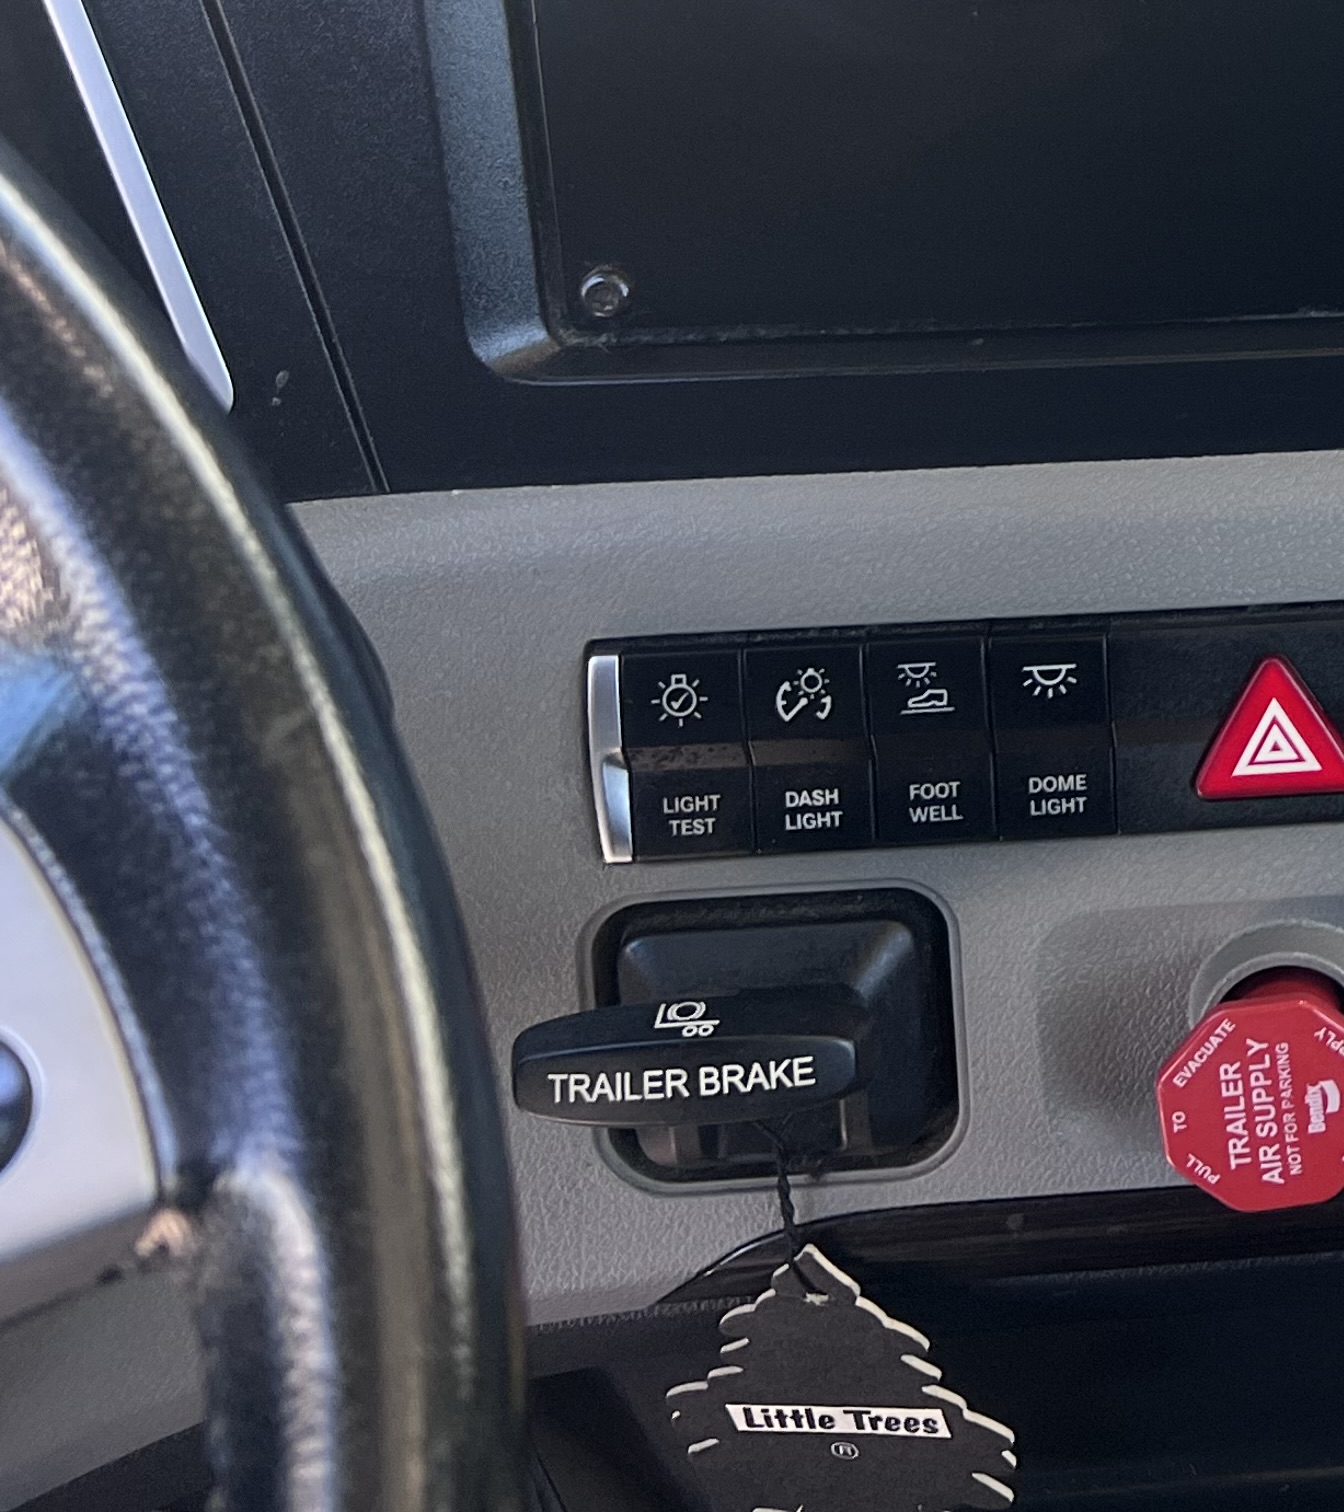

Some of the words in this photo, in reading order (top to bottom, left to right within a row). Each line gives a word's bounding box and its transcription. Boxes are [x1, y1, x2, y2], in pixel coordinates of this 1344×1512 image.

[909, 781, 961, 800] FOOT
[1029, 773, 1087, 793] DOME
[663, 794, 721, 814] LIGHT
[785, 788, 839, 808] DASH
[1030, 796, 1087, 816] LIGHT
[669, 817, 716, 836] TEST
[785, 811, 843, 830] LIGHT
[909, 804, 963, 823] WELL
[1173, 1018, 1236, 1088] EVACUATE
[548, 1067, 689, 1104] TRAILER
[699, 1056, 816, 1097] BRAKE
[1246, 1039, 1278, 1138] SUPPLY
[1276, 1042, 1296, 1111] PARKING
[1172, 1112, 1187, 1133] TO
[1220, 1061, 1252, 1170] TRAILER
[1283, 1112, 1299, 1144] FOR
[1186, 1154, 1221, 1184] PULL
[1259, 1144, 1285, 1184] AIR
[1286, 1146, 1302, 1175] NOT
[742, 1406, 836, 1430] Little
[843, 1409, 939, 1433] Trees
